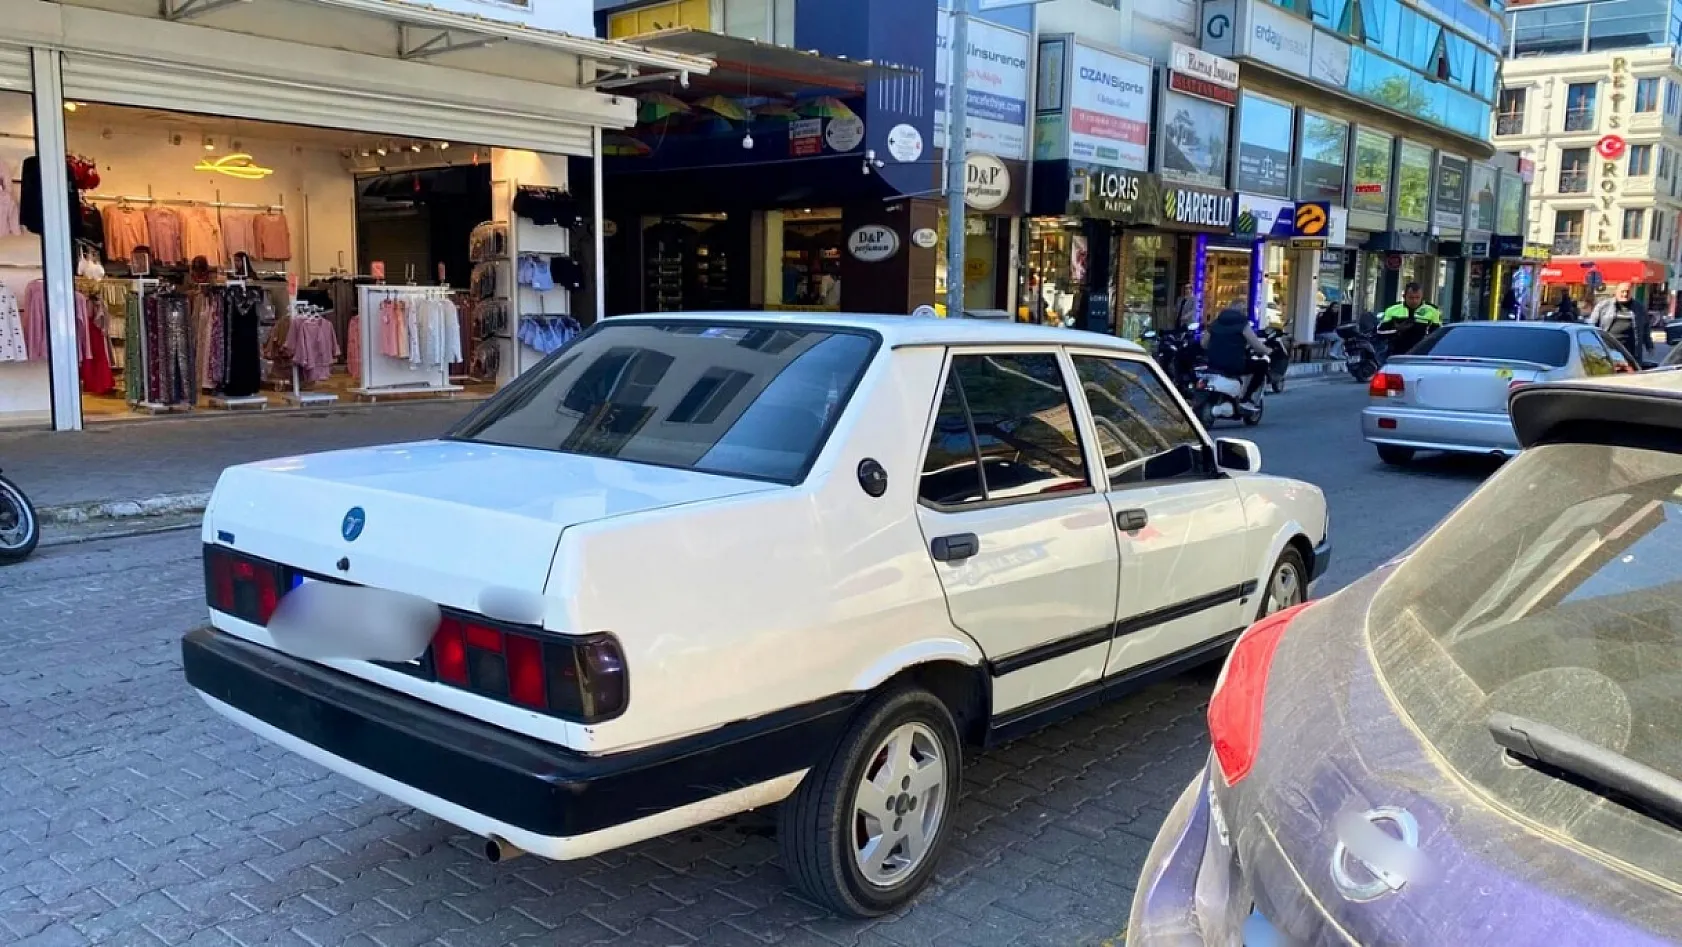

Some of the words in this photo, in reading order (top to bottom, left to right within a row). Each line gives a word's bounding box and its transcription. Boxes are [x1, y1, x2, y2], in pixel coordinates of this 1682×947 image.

[967, 164, 1000, 184] D&P
[1100, 171, 1139, 200] LORIS
[1105, 201, 1132, 214] PARFUM
[1176, 189, 1232, 226] BARGELLO
[1598, 162, 1617, 243] ROYAL
[858, 231, 884, 243] D&P
